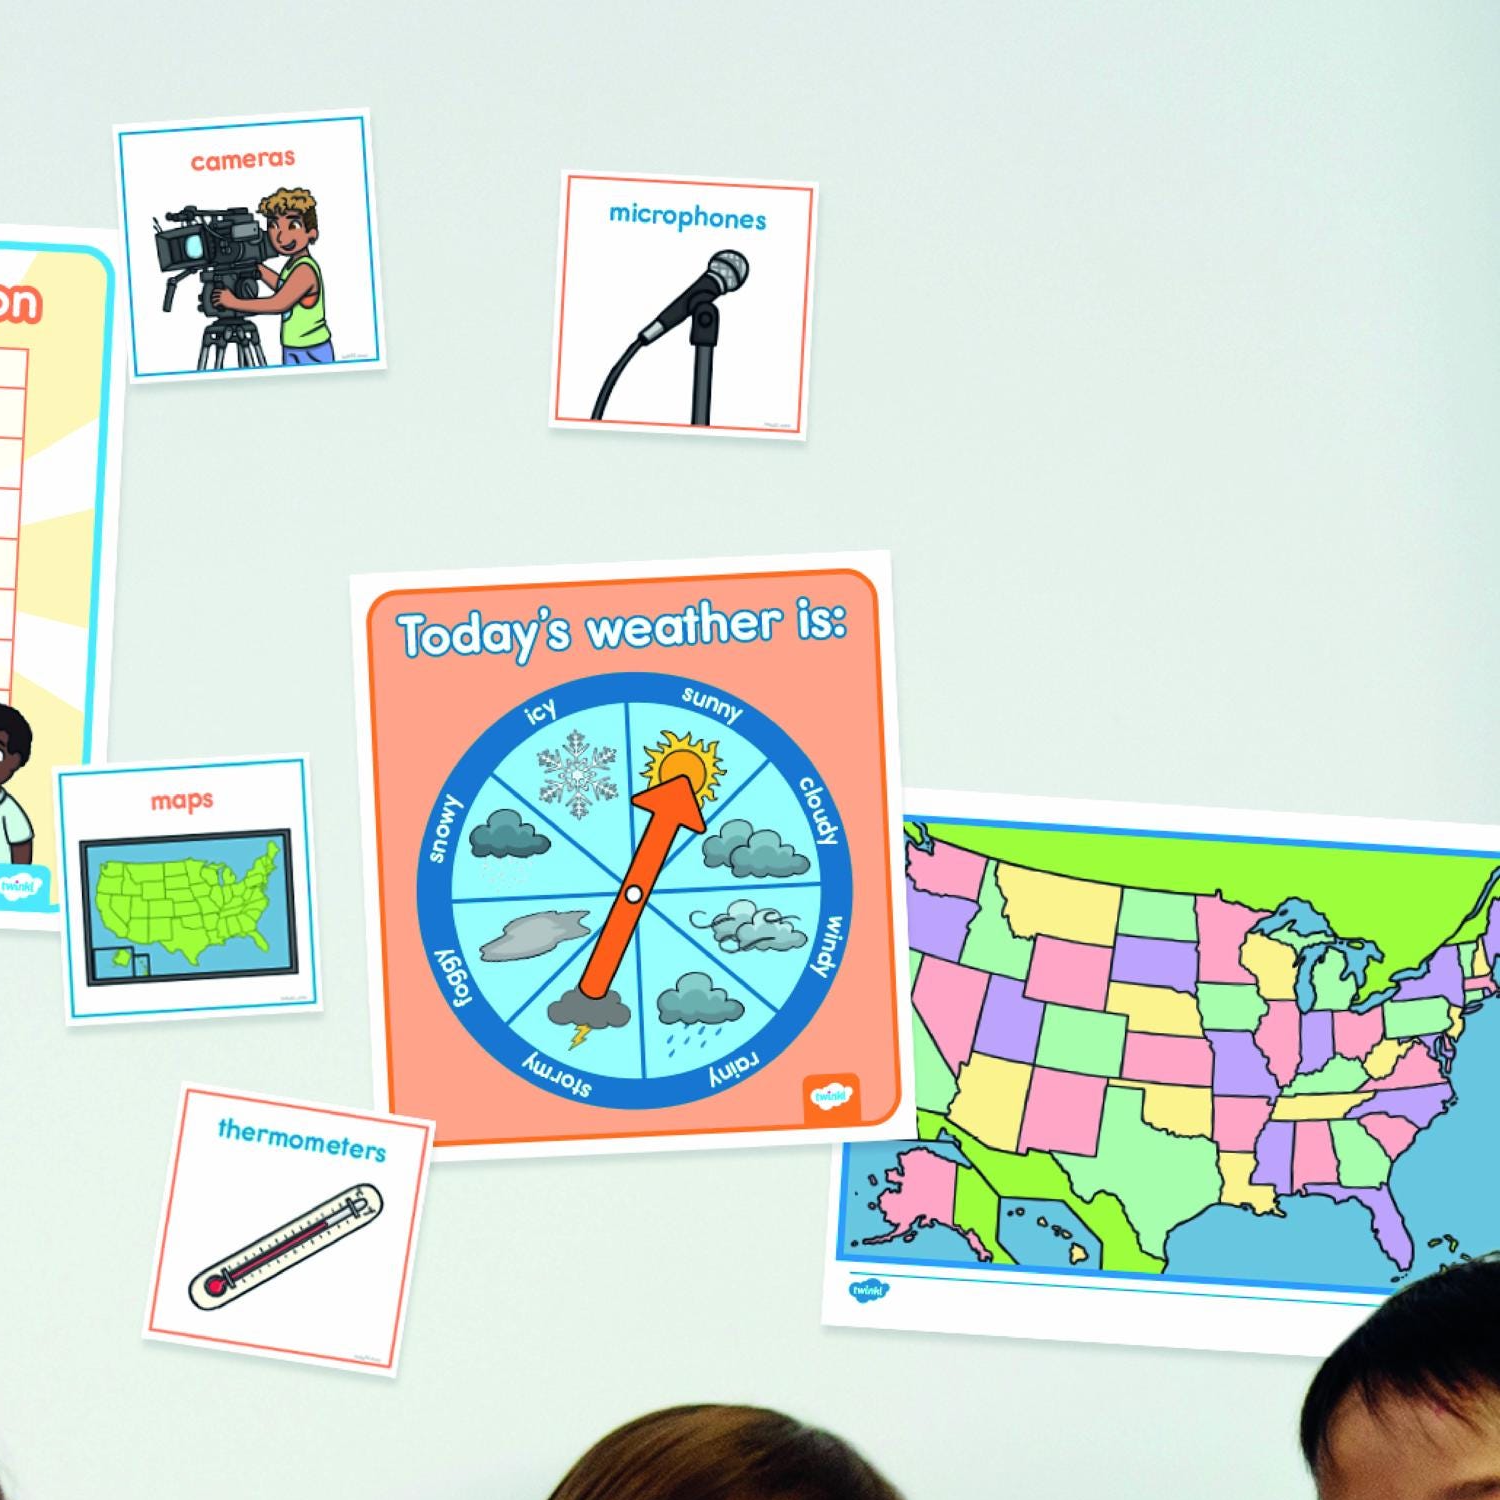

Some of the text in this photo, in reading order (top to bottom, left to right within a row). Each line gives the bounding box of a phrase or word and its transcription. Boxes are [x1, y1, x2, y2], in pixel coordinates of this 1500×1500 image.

[191, 147, 296, 172] cameras
[609, 201, 768, 233] microphones
[396, 598, 847, 667] Today's weather is:
[523, 697, 558, 727] icy
[681, 686, 744, 726] sunny
[150, 788, 214, 816] maps
[798, 775, 840, 847] cloudy
[428, 793, 465, 865] snowy
[1, 879, 35, 893] twinkl
[813, 915, 843, 979] windy
[432, 947, 474, 1008] foggy
[521, 1050, 593, 1099] stormy
[708, 1050, 759, 1088] rainy
[815, 1090, 846, 1102] twinkl
[218, 1117, 388, 1165] thermometers
[853, 1284, 883, 1296] twinkl
